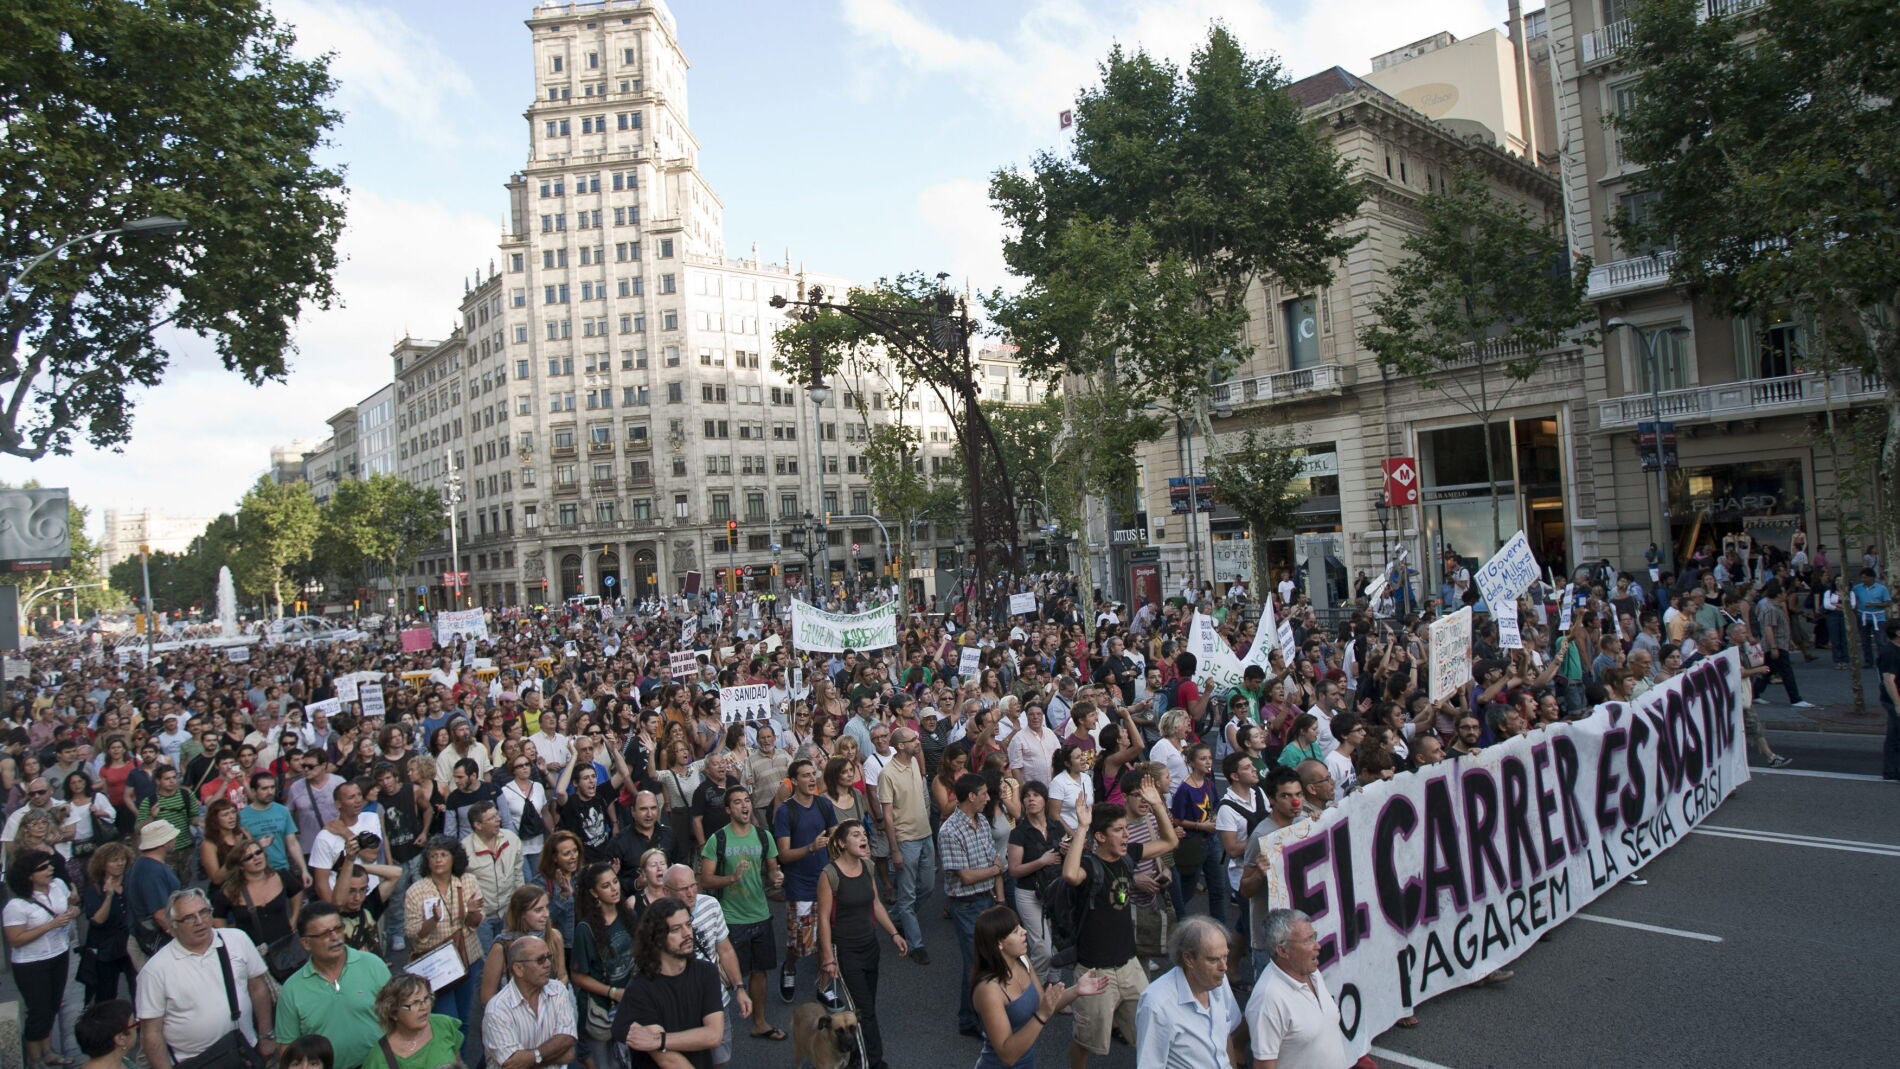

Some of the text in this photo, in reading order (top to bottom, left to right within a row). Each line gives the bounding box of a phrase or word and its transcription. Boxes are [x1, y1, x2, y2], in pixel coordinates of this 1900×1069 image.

[1400, 469, 1410, 481] M
[1692, 495, 1777, 512] PHARD
[1478, 537, 1526, 588] El Govern
[1486, 582, 1504, 602] dels
[1202, 660, 1221, 676] DE
[734, 685, 768, 702] SANIDAD
[1283, 816, 1370, 972] EL
[1371, 734, 1589, 937] CARRER
[1595, 702, 1650, 833] ÉS
[1643, 656, 1736, 807] NOSTRE
[1397, 867, 1571, 1008] PAGAREM
[1587, 839, 1619, 888] LA
[1620, 802, 1677, 867] SEVA
[1682, 765, 1722, 828] CRISI
